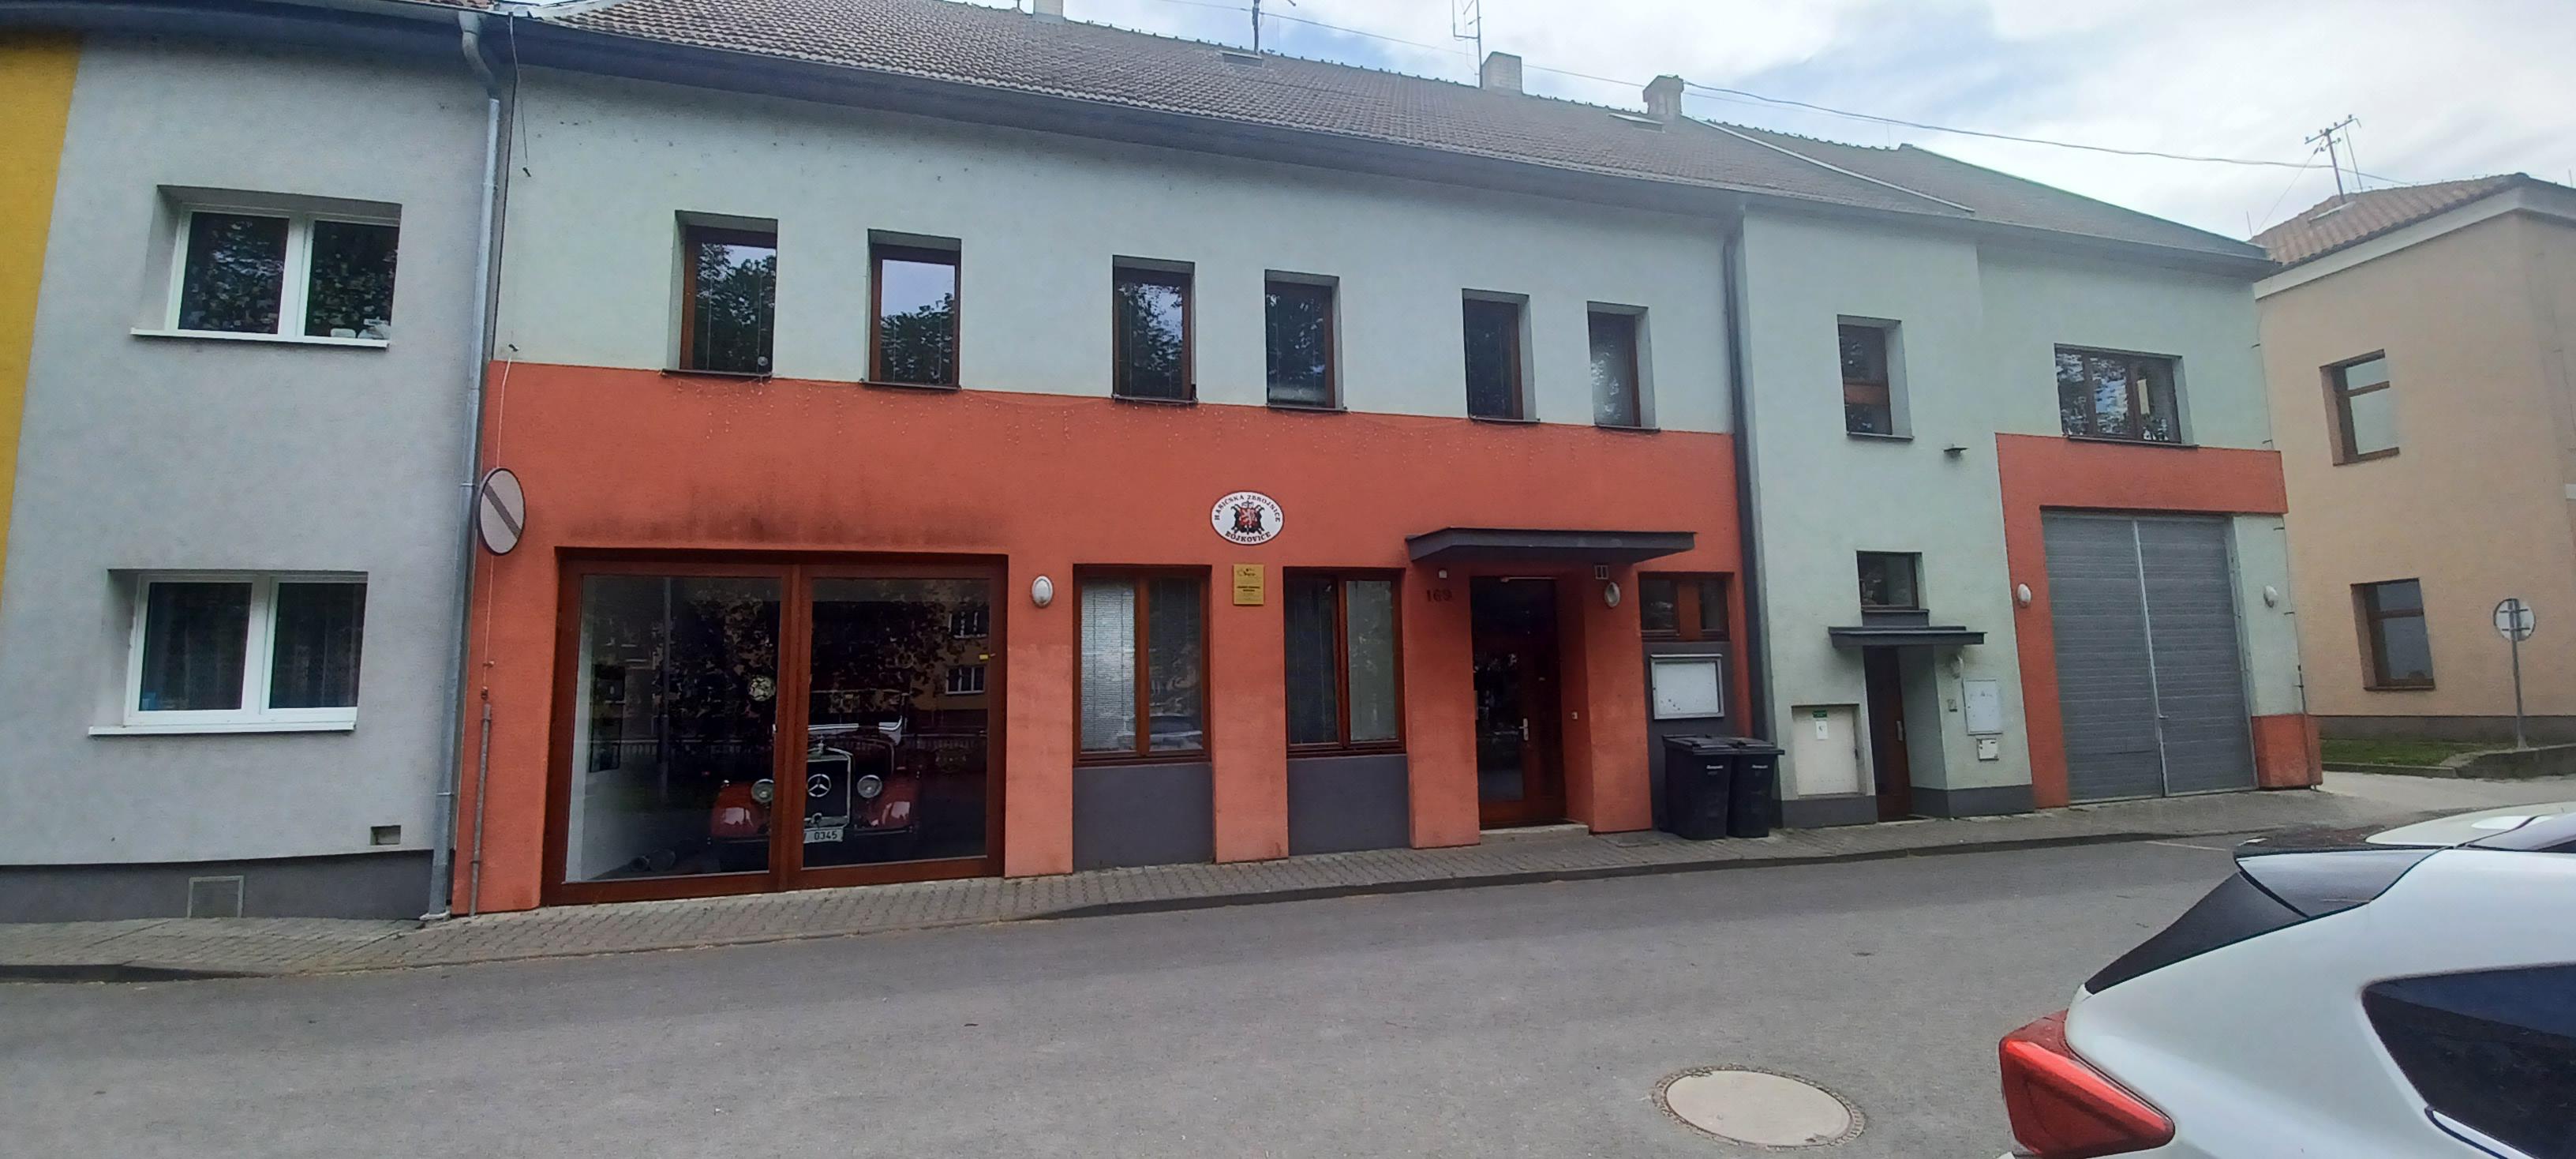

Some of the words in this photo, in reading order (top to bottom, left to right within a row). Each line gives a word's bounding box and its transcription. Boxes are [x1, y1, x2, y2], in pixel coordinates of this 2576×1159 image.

[1247, 495, 1281, 523] ZBROJNICE
[1224, 531, 1271, 543] BOJKOVICE
[814, 831, 838, 841] 0345
